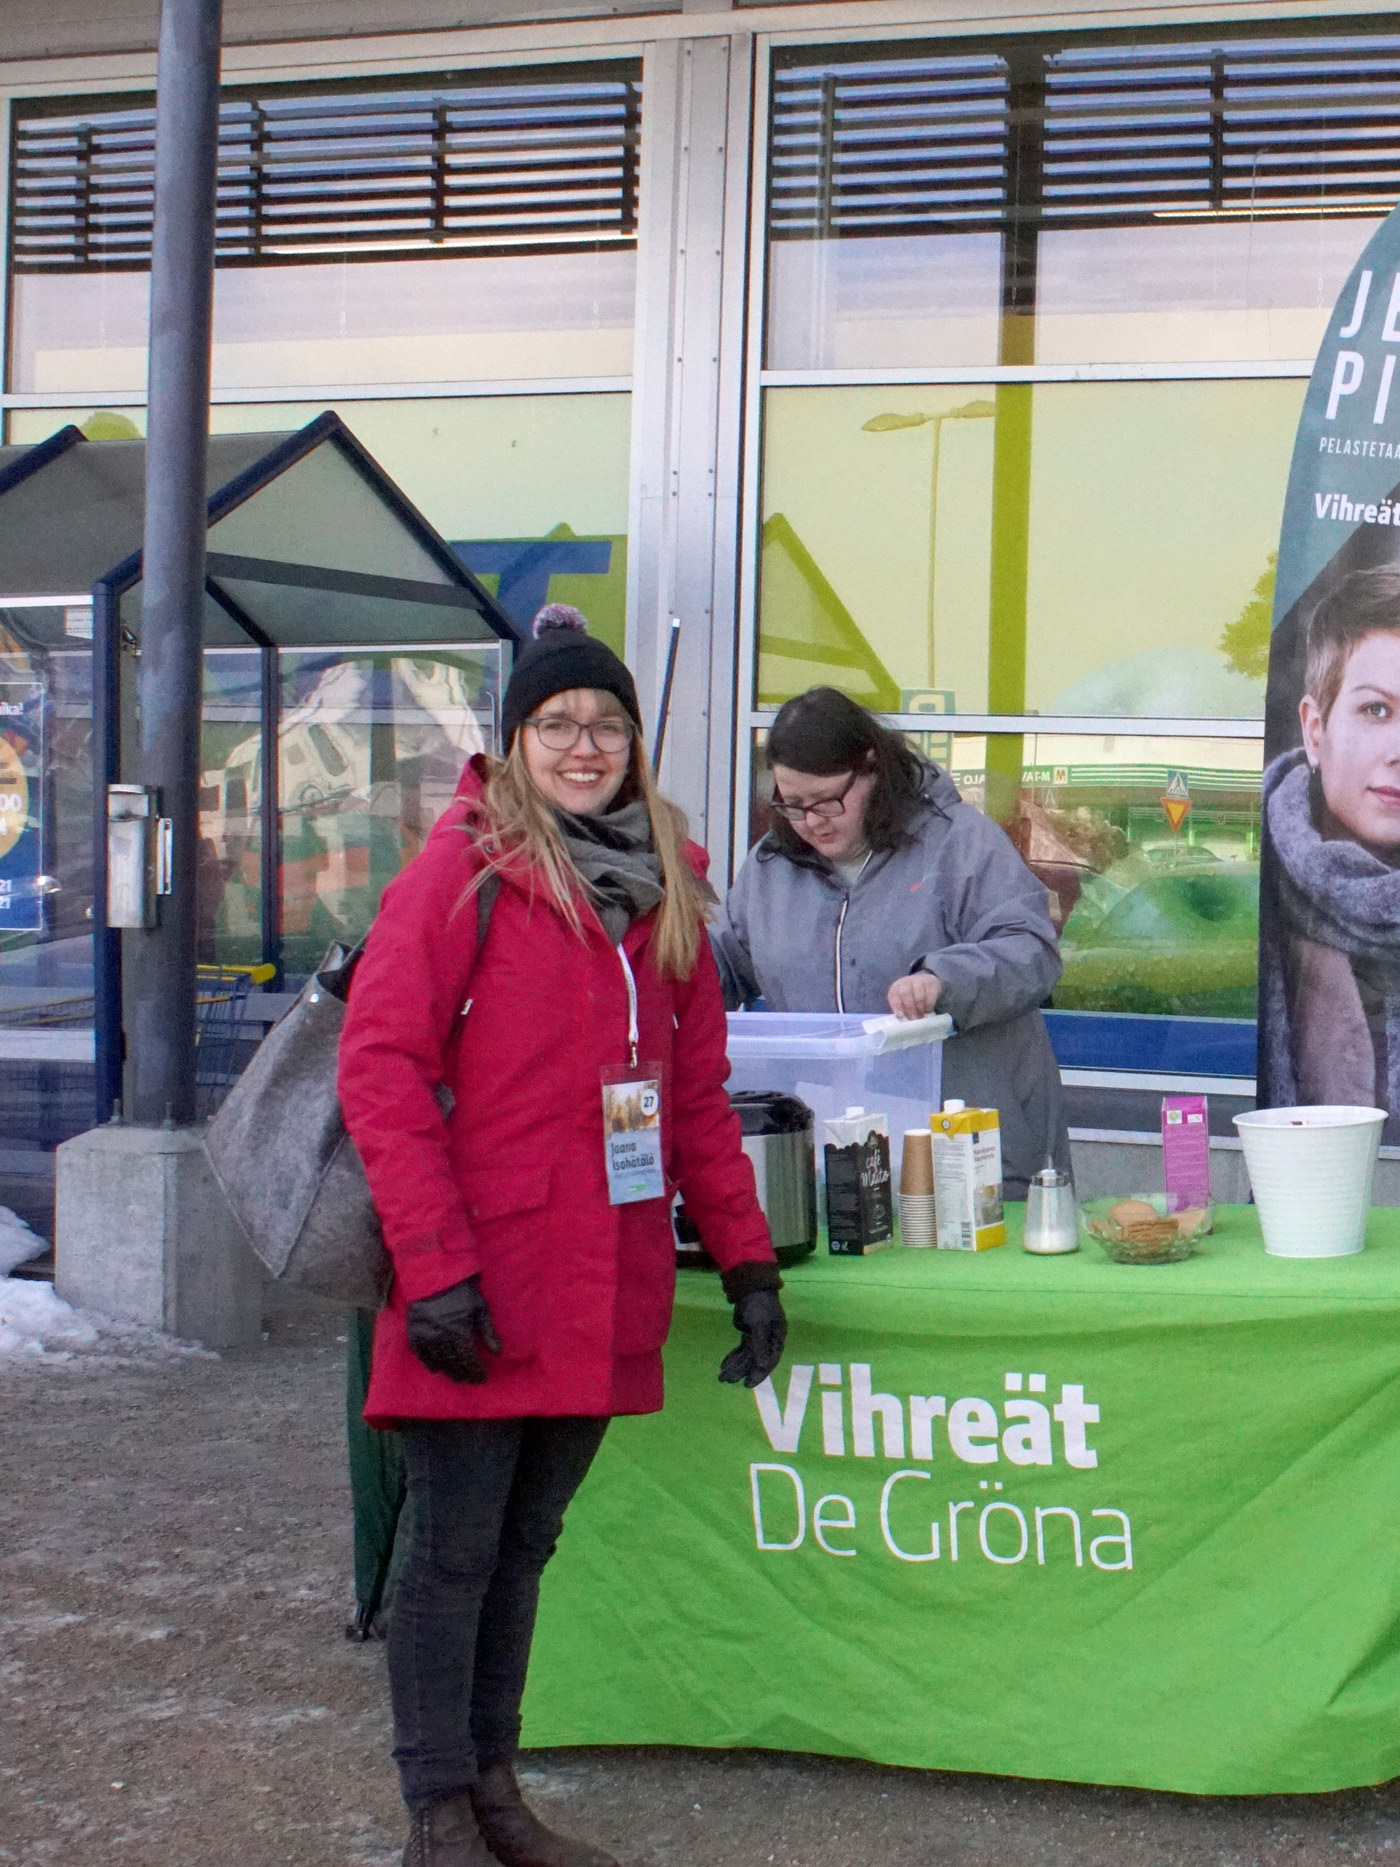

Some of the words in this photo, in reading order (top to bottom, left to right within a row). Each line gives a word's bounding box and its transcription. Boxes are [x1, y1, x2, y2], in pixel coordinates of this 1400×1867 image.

[750, 1362, 1100, 1469] Vihreät
[749, 1462, 857, 1557] De
[880, 1469, 1134, 1571] Gröna
